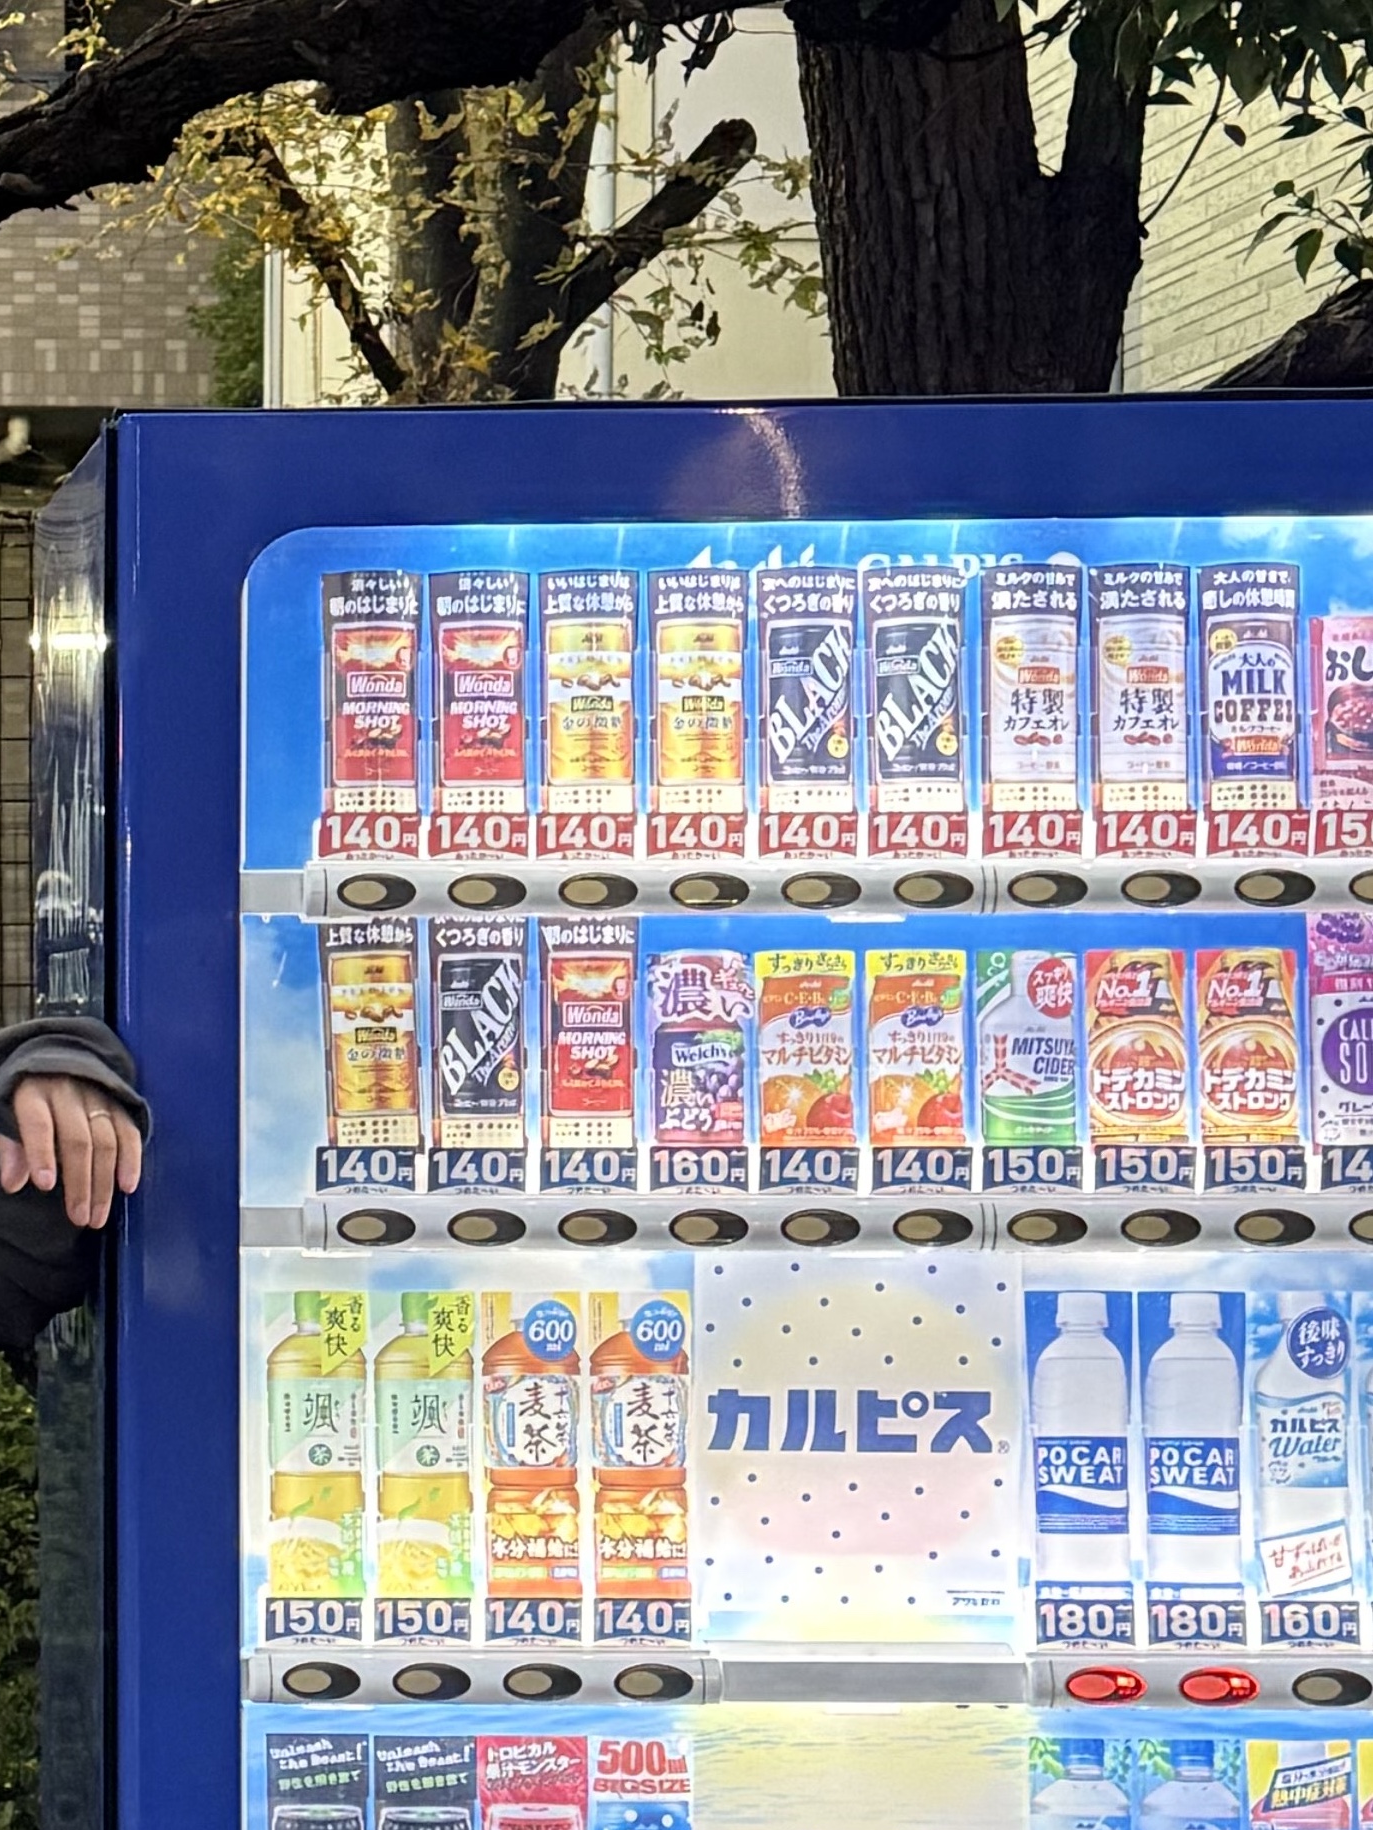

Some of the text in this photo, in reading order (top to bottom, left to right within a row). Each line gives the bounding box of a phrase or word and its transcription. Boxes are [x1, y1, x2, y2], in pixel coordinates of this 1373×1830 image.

[992, 589, 1077, 610] 満たされる
[1100, 589, 1187, 610] 満たされる
[351, 675, 404, 694] Wonda
[459, 675, 512, 694] Wonda
[769, 623, 851, 764] BLACK
[876, 621, 958, 762] BLACK
[1222, 669, 1287, 696] MILK
[342, 701, 411, 715] MORNING
[450, 701, 517, 715] MORNING
[1011, 687, 1064, 715] 特製
[1120, 687, 1174, 715] 特製
[354, 716, 401, 729] SHOT
[462, 716, 509, 729] SHOT
[1003, 716, 1069, 732] カフェオレ
[1112, 716, 1179, 732] カフェオレ
[436, 927, 524, 947] くつろぎの香り
[767, 952, 813, 973] すっきり
[879, 952, 925, 972] すっきり
[1096, 970, 1153, 999] No.1
[1208, 970, 1264, 998] No.1
[1036, 982, 1073, 1010] 爽快
[567, 1005, 620, 1023] Wonda
[439, 958, 522, 1096] BLACK
[558, 1032, 626, 1045] MORNING
[570, 1046, 616, 1060] SHOT
[762, 1046, 852, 1066] マルチビタミン
[873, 1046, 962, 1066] マルチビタミン
[1033, 1056, 1075, 1075] CIDER
[1094, 1067, 1185, 1093] ドデカミン
[1204, 1067, 1297, 1093] ドデカミン
[1105, 1092, 1177, 1111] ストロング
[1214, 1091, 1292, 1111] ストロング
[659, 1107, 713, 1130] ぶどう
[347, 1295, 363, 1333] 香る
[454, 1295, 471, 1334] 香る
[324, 1307, 348, 1357] 爽快
[432, 1308, 456, 1358] 爽快
[528, 1320, 574, 1342] 600
[636, 1320, 683, 1342] 600
[1298, 1317, 1341, 1346] 後味
[1296, 1340, 1346, 1369] すっきり
[518, 1381, 557, 1462] 麦茶
[626, 1381, 665, 1463] 麦茶
[707, 1388, 993, 1453] カルピス
[1269, 1418, 1341, 1434] カルピス
[1268, 1435, 1342, 1459] Water
[1038, 1466, 1124, 1485] SWEAT
[1150, 1467, 1235, 1486] SWEAT
[487, 1742, 557, 1765] トロピカル
[486, 1756, 582, 1780] 果汁モンスター
